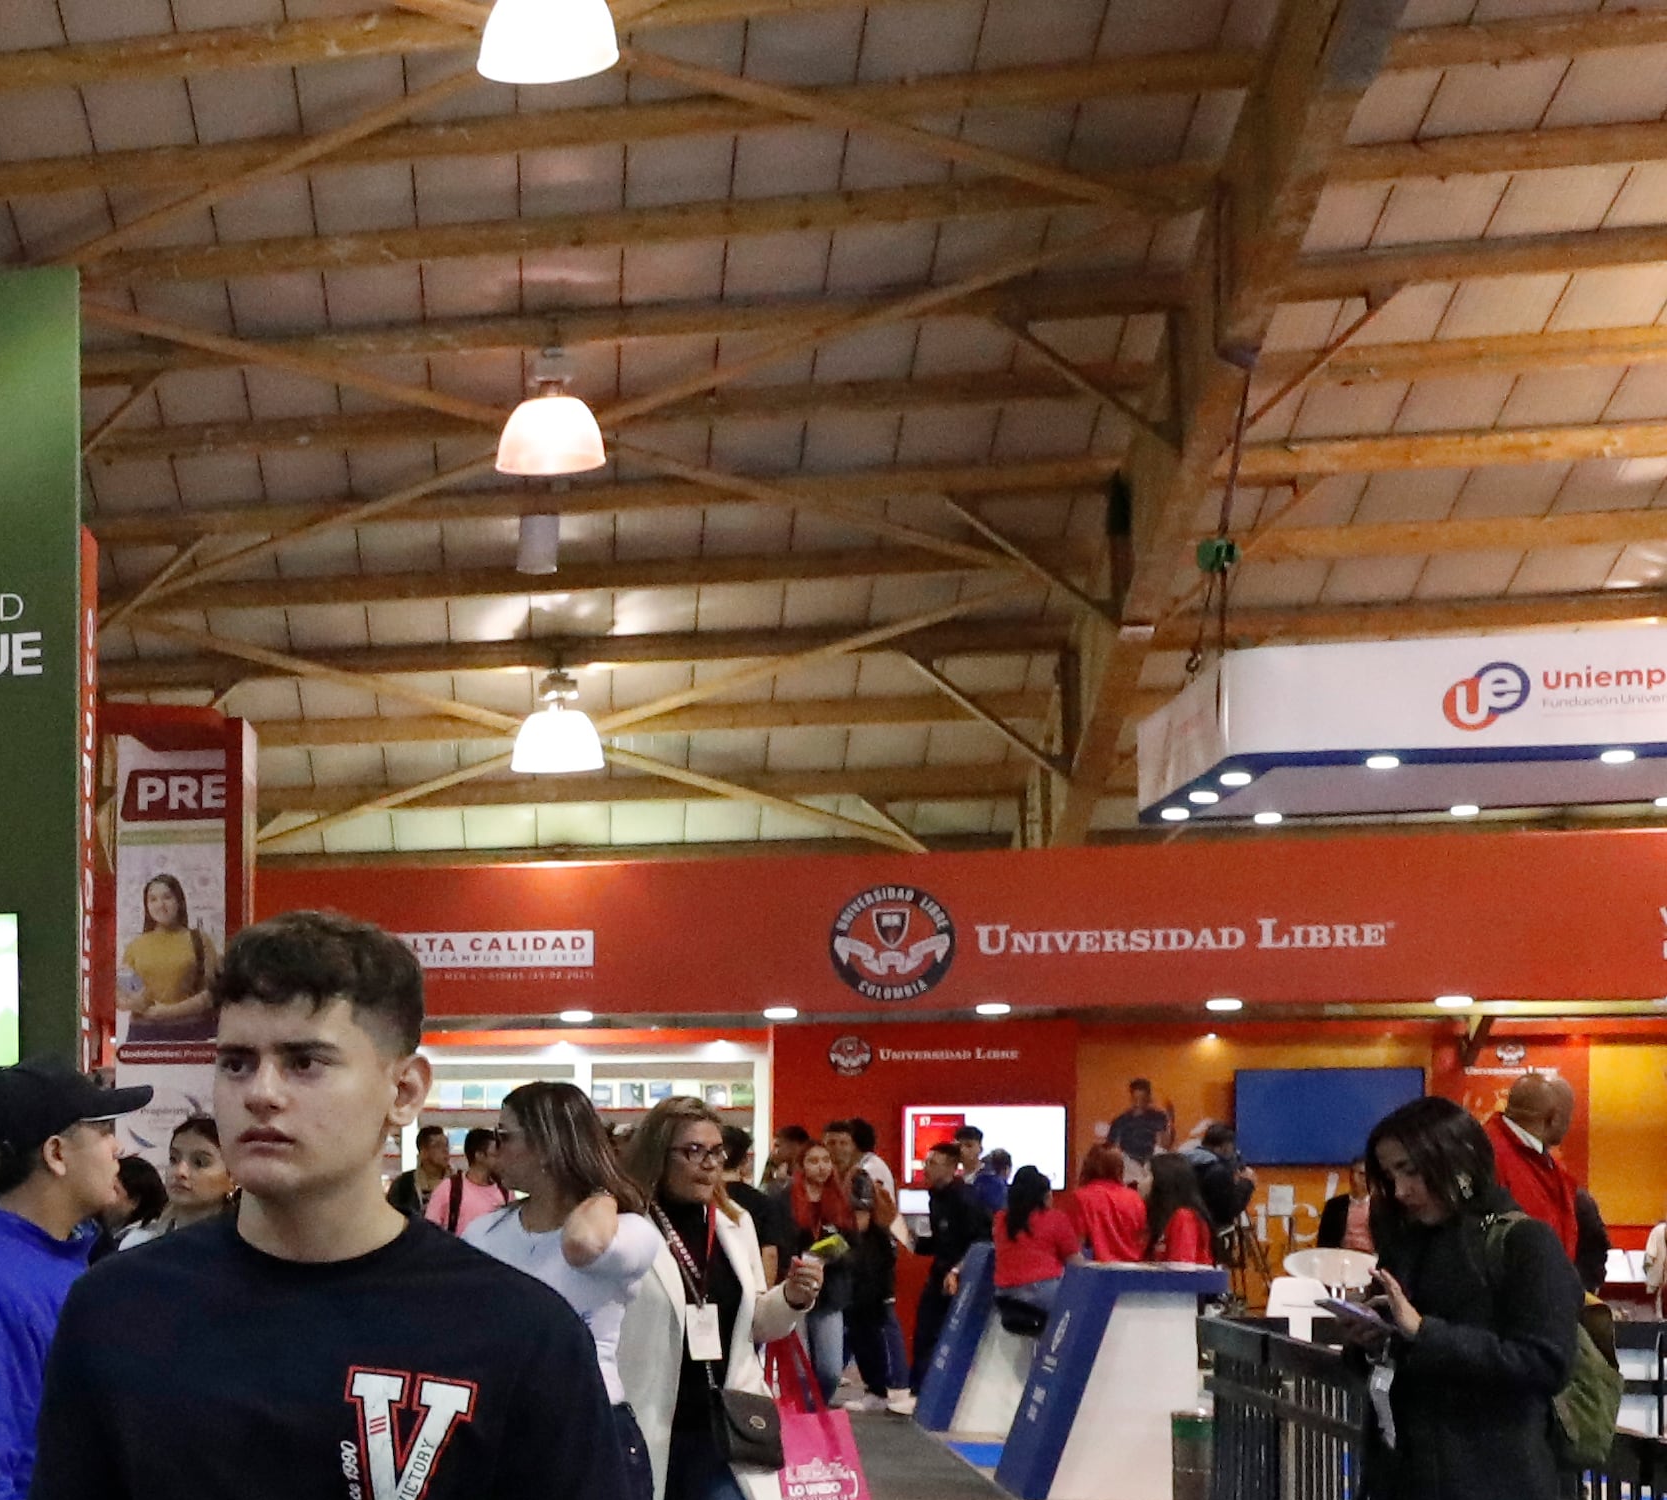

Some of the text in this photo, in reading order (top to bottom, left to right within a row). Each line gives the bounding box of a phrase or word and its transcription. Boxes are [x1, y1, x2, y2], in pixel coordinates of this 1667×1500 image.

[1543, 665, 1666, 690] Uniemp
[1542, 695, 1618, 708] Fundación
[137, 775, 227, 812] PRE
[835, 886, 915, 932] UNIVERSIDAD
[412, 936, 587, 952] LTA CALIDAD
[975, 917, 1388, 956] UNIVERSIDAD LIBRE
[857, 979, 928, 1000] COLOMBIA
[339, 1440, 360, 1481] 1990
